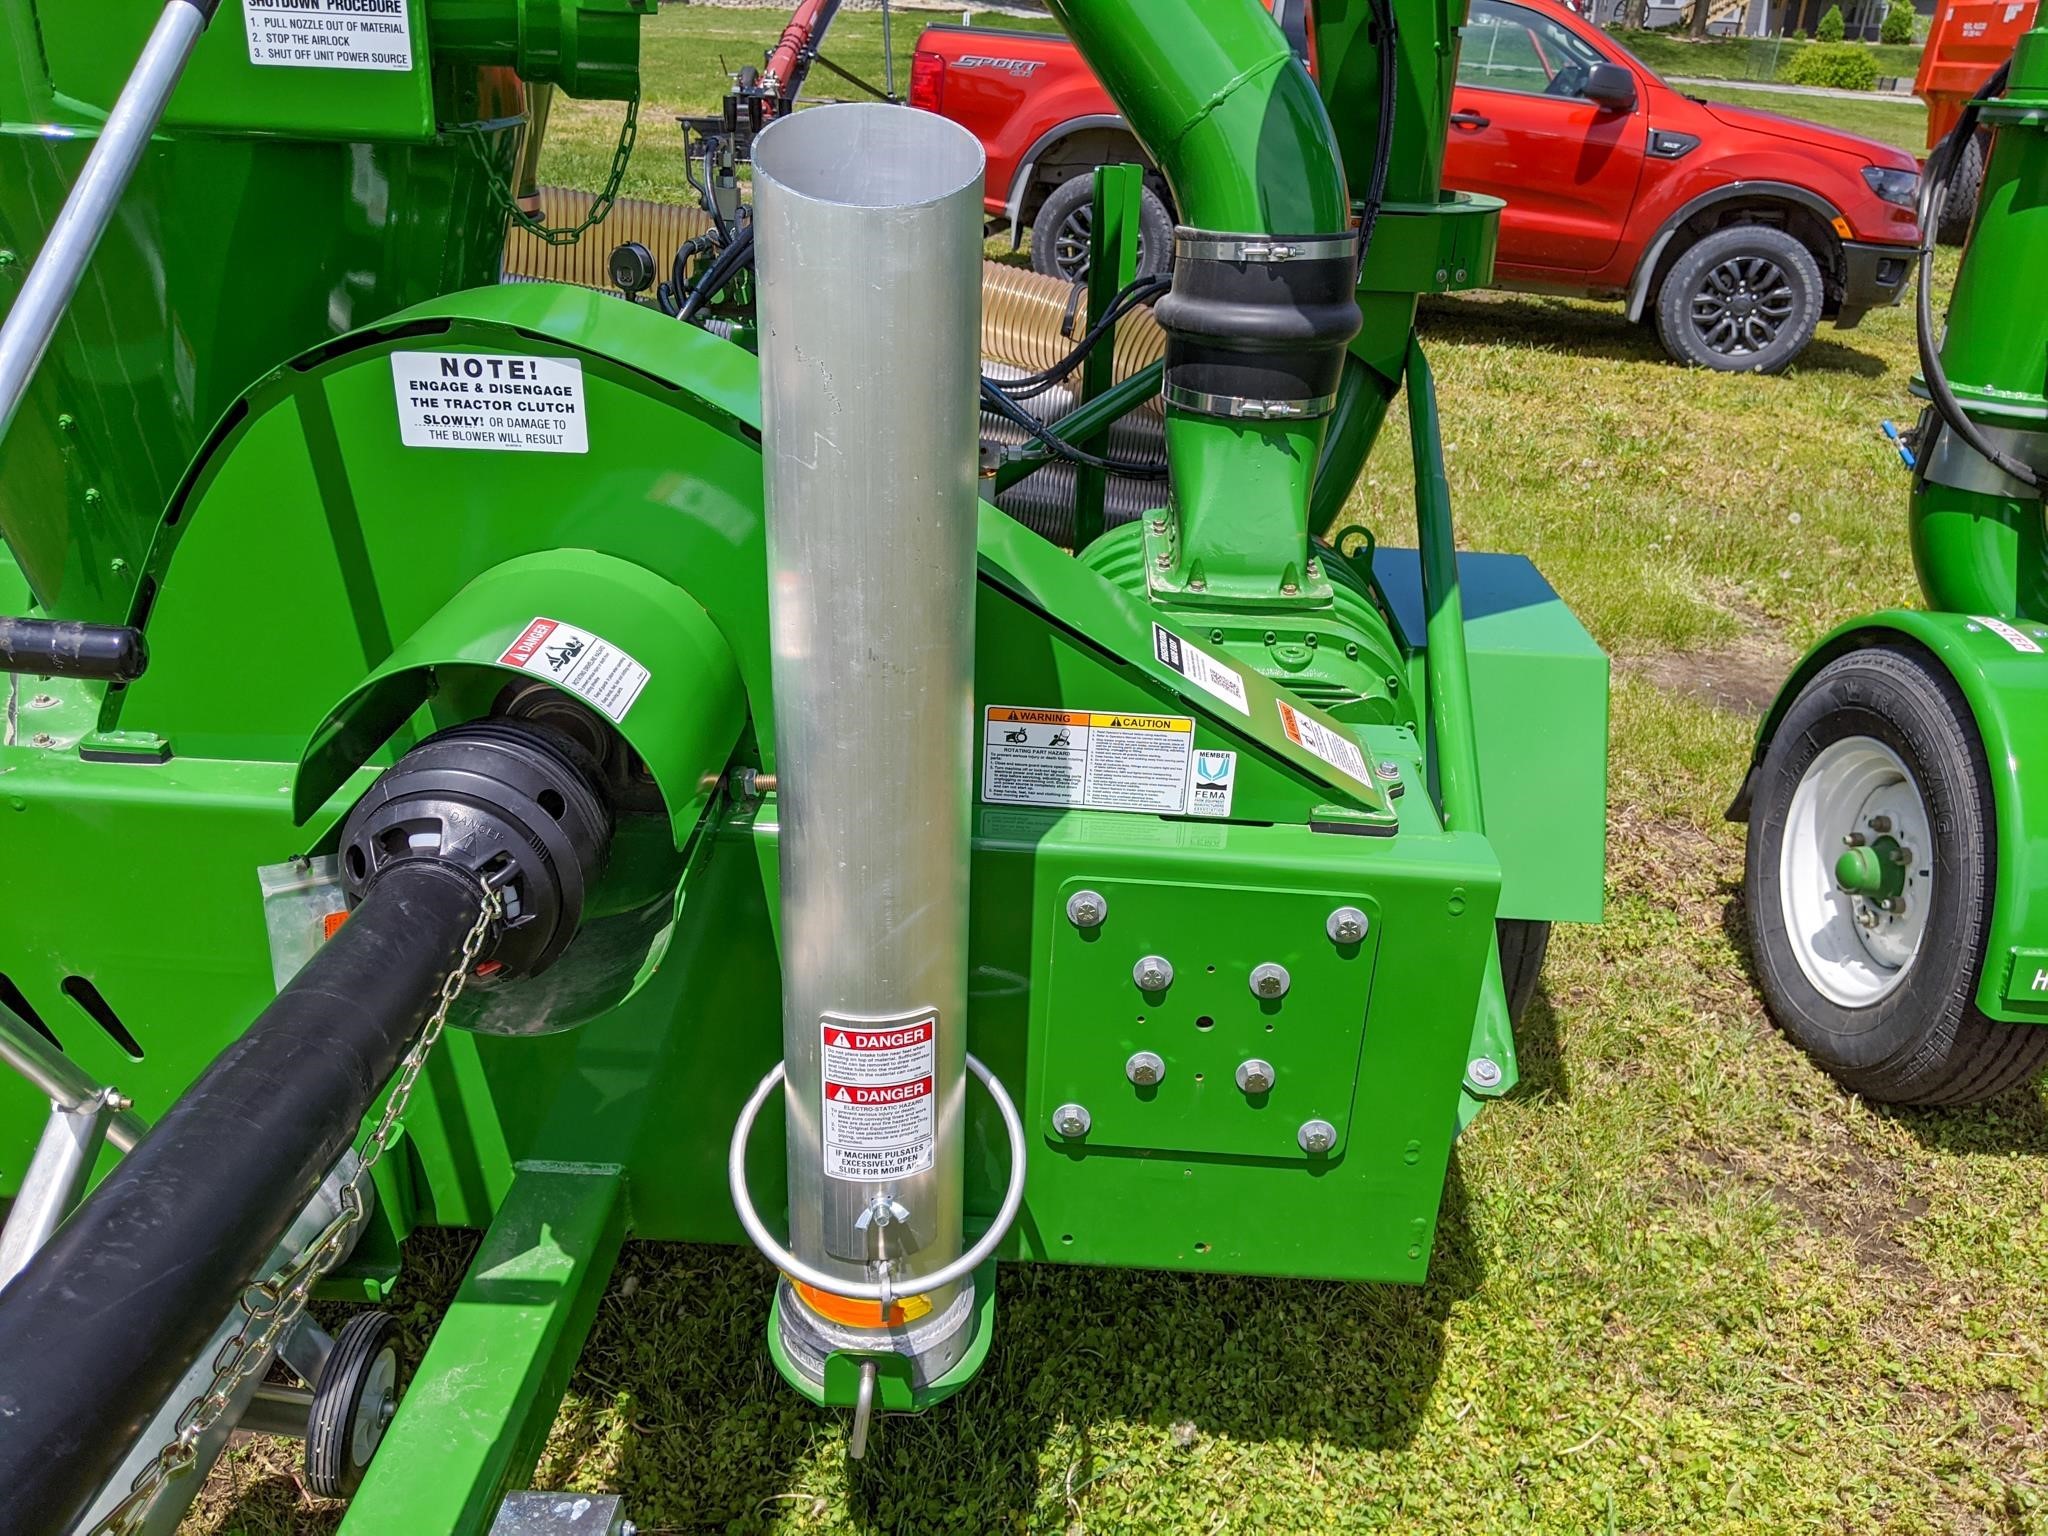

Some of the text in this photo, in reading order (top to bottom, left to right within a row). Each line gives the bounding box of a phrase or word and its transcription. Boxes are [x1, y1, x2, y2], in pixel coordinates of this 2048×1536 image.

[328, 0, 402, 13] PROCEDURE
[251, 18, 404, 34] 1. PULL NOZZLE OUT OF MATERIAL
[252, 33, 349, 46] 2. STOP THE AIRLOCK
[254, 48, 407, 64] 3. SHUT OFF UNIT POWER SOURCE
[950, 55, 1046, 71] SPORT
[440, 358, 537, 380] NOTE!
[410, 381, 572, 396] ENGAGE & DISENGAGE
[411, 398, 575, 413] THE TRACTOR CLUTCH
[423, 414, 566, 430] SLOWLY! OR DAMAGE TO
[429, 430, 563, 444] THE BLOWER WILL RESULT
[521, 624, 550, 652] DANGER
[1995, 628, 2035, 650] STEP
[1020, 712, 1070, 723] WARNING
[1123, 718, 1171, 728] CAUTION
[1195, 791, 1225, 799] FEMA
[450, 811, 504, 840] DANGER
[856, 1029, 924, 1048] DANGER
[857, 1083, 924, 1102] DANGER
[899, 1099, 923, 1109] HAZARD
[844, 1151, 882, 1159] MACHINE
[885, 1144, 924, 1158] PULSATES
[898, 1154, 918, 1165] OPEN
[839, 1166, 861, 1174] SLIDE
[881, 1166, 904, 1174] MORE
